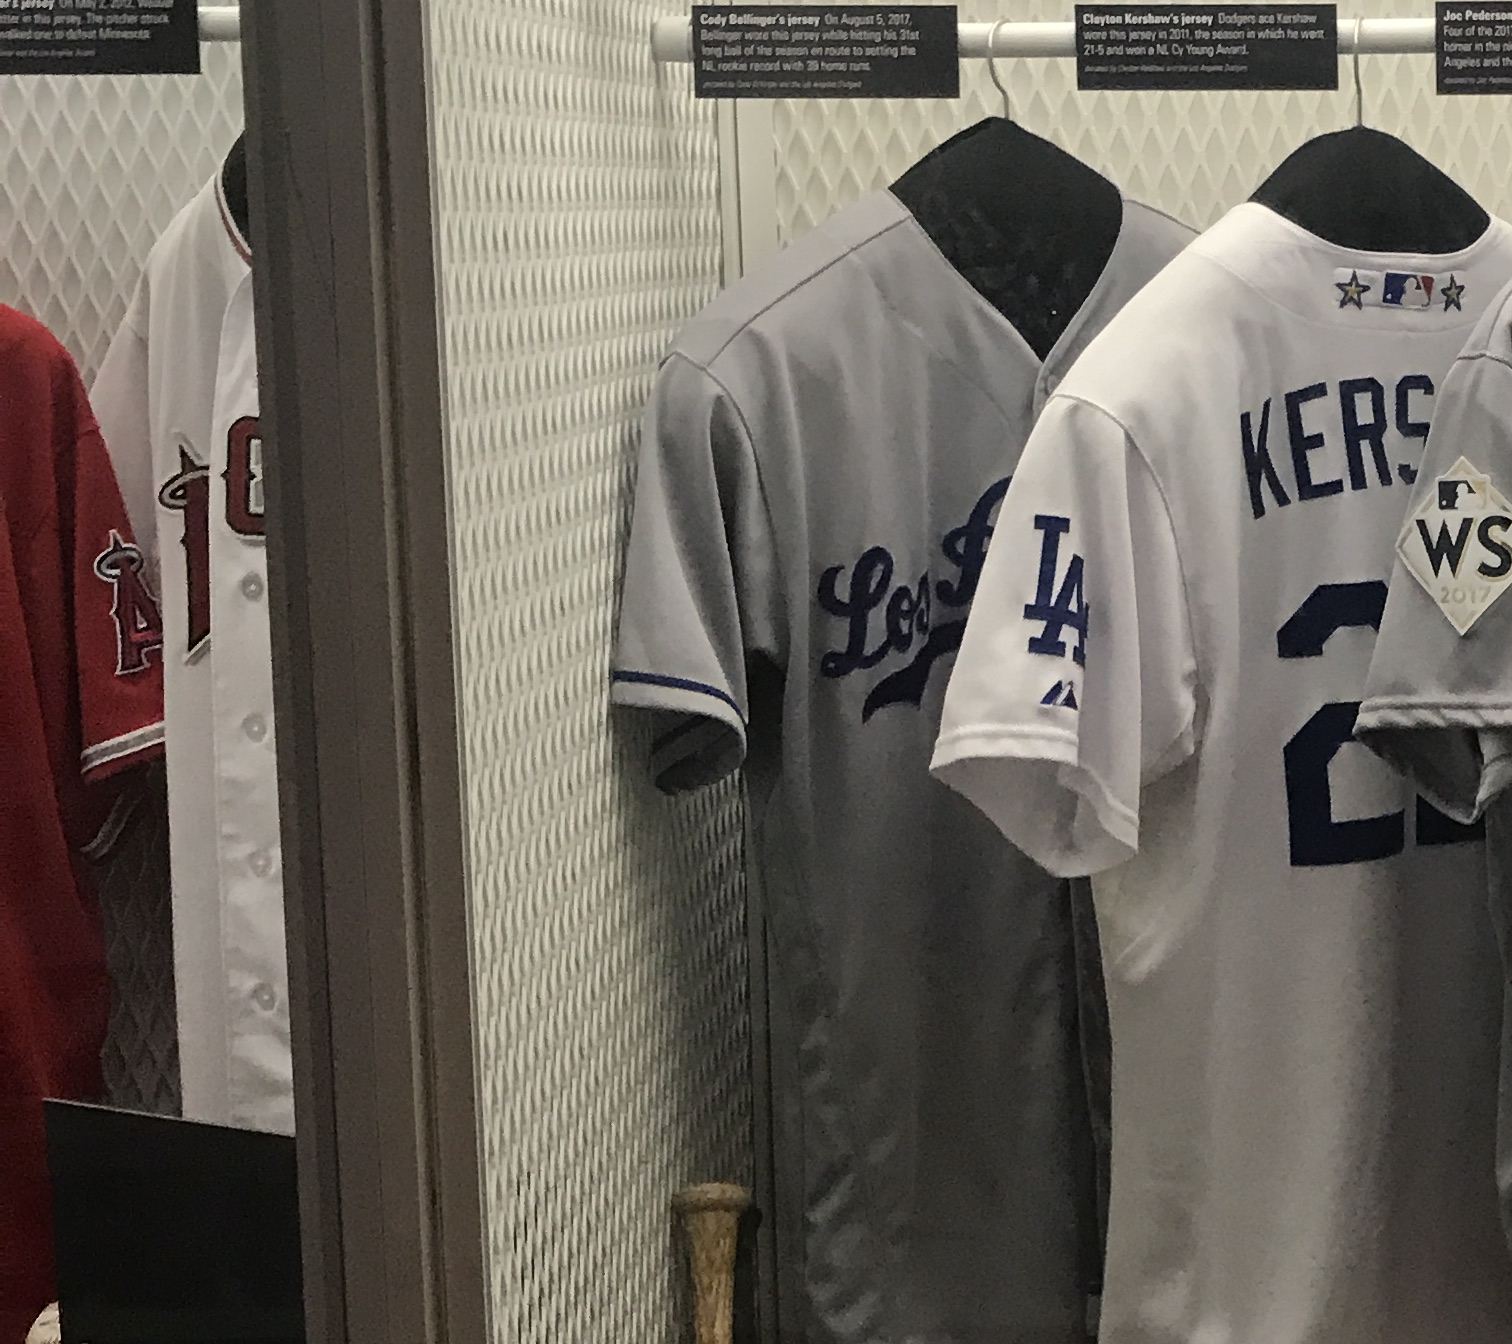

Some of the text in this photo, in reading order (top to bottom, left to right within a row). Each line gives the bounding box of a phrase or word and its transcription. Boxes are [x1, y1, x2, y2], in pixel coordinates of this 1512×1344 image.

[700, 14, 820, 27] Cody Bellinger's jersey
[1416, 516, 1512, 580] WS
[817, 546, 931, 678] Los
[1024, 515, 1089, 666] LA
[1440, 586, 1491, 605] 2017
